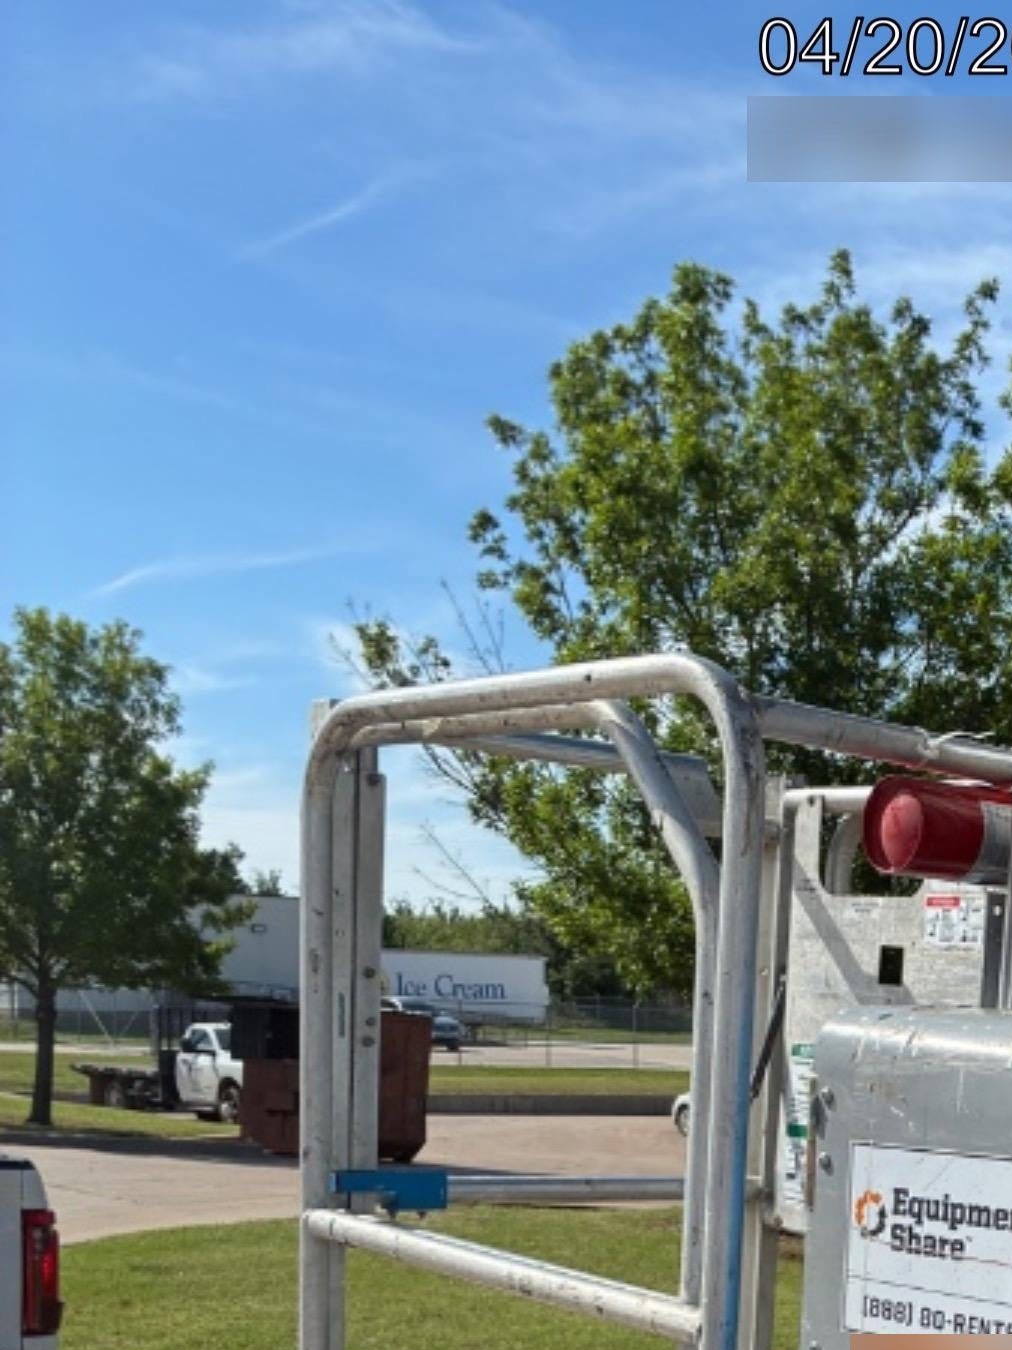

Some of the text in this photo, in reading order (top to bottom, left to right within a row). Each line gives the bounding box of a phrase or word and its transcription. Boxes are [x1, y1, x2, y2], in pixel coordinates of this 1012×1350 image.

[395, 972, 506, 1000] Ice Cream
[890, 1223, 966, 1260] Share
[863, 1295, 913, 1327] (888)
